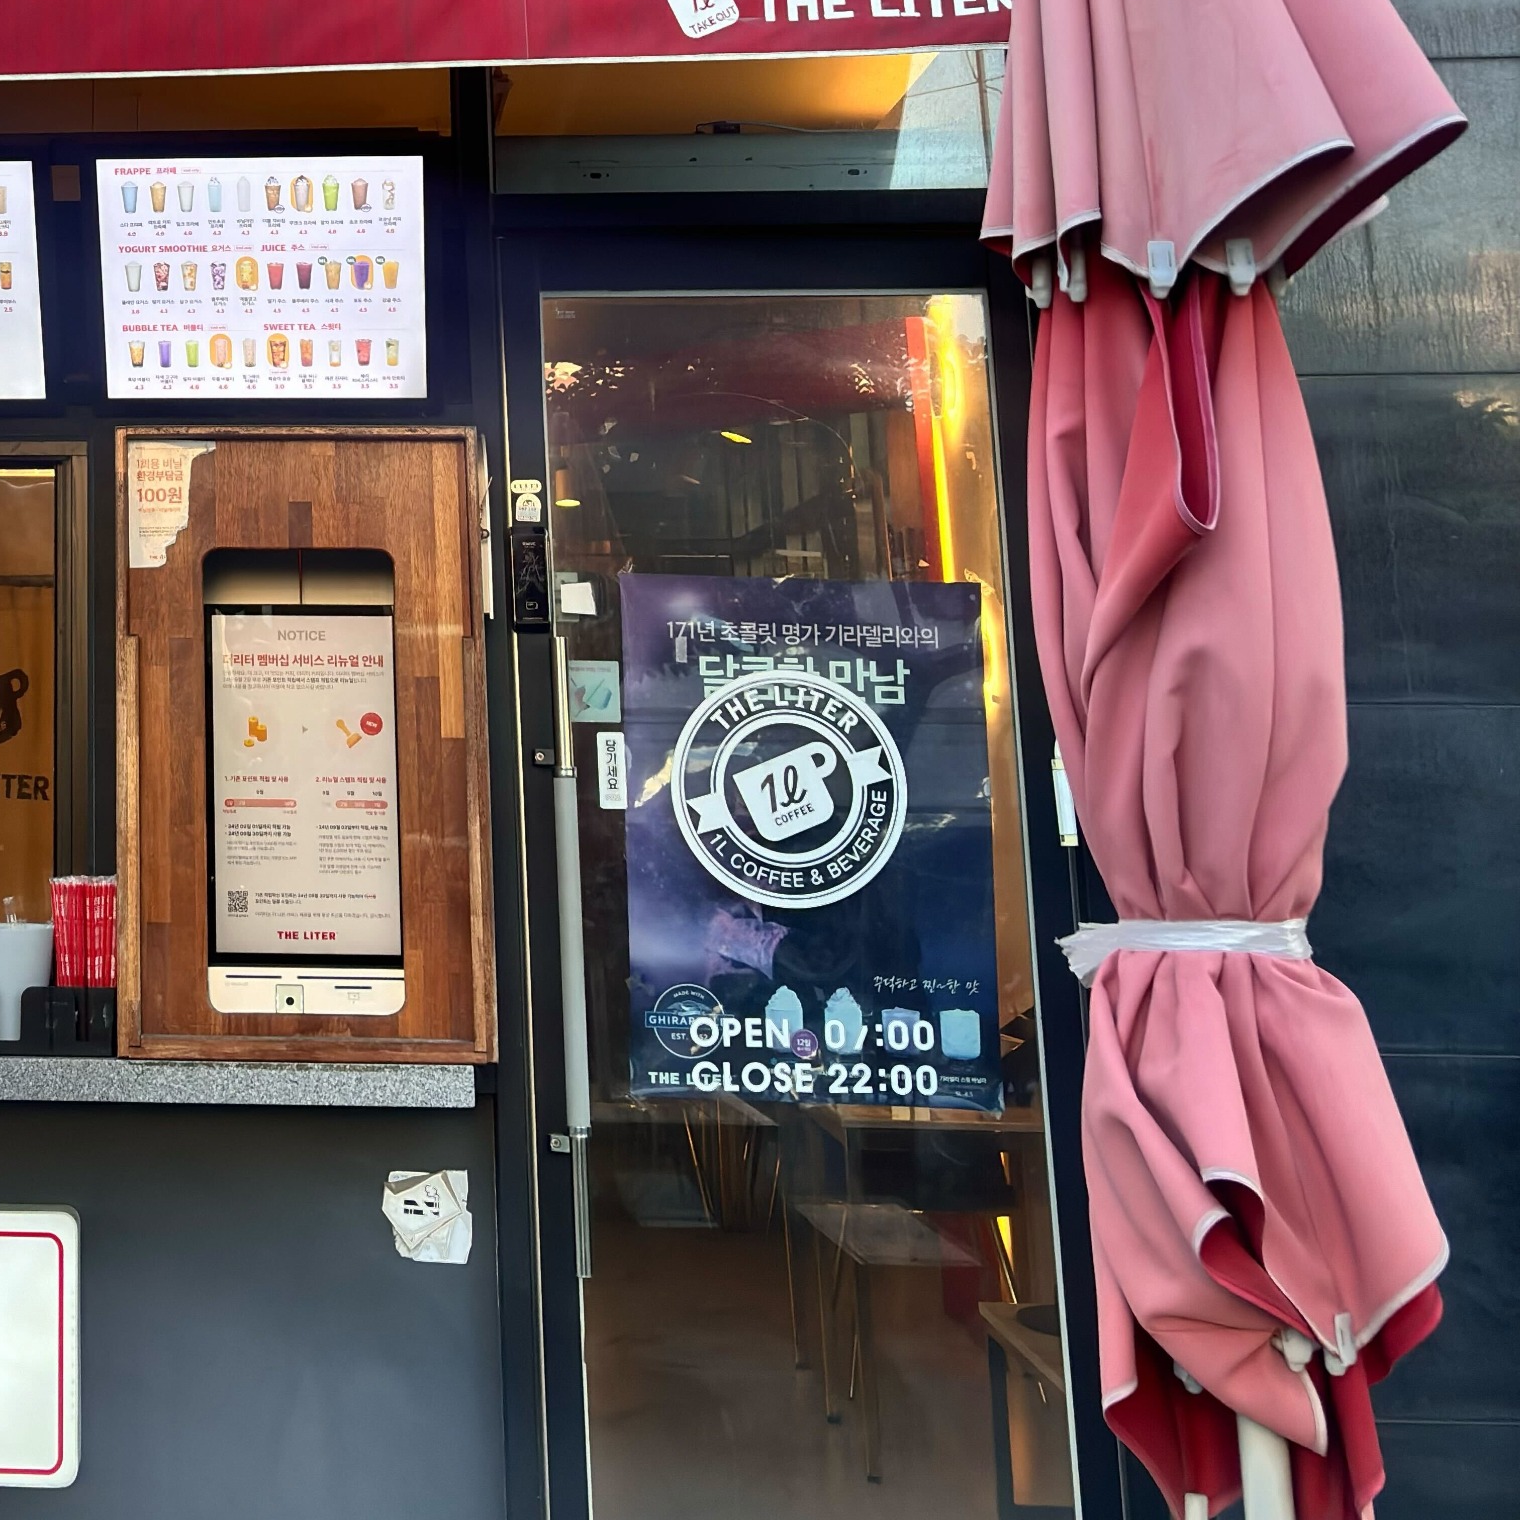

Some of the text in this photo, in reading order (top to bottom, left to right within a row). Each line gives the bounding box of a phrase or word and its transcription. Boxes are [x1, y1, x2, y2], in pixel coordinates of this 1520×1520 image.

[114, 167, 151, 175] FRAPPE
[118, 245, 157, 254] YOGURT
[158, 244, 208, 253] SMOOTHIE
[260, 244, 287, 252] JUICE
[122, 324, 159, 332] BUBBLE
[160, 324, 179, 332] TEA
[263, 323, 295, 331] SWEET
[297, 323, 316, 331] TEA
[136, 470, 184, 482] 환경부담금
[136, 486, 184, 504] 100원
[277, 630, 326, 641] NOTICE
[666, 620, 939, 649] 171년 초콜릿 명가 기라델리와의
[257, 654, 289, 668] 멤버십
[292, 654, 325, 668] 서비스
[327, 655, 360, 668] 리뉴얼
[362, 655, 384, 668] 안내
[828, 657, 911, 705] 만남
[710, 685, 859, 734] THE LITER
[606, 739, 619, 790] 당기세요
[774, 803, 816, 827] COFFEE
[729, 852, 805, 888] COFFEE
[810, 868, 825, 886] &
[826, 789, 888, 880] BEVERAGE
[277, 930, 337, 941] THE LITER
[670, 1032, 689, 1041] EST.
[689, 1017, 791, 1049] OPEN
[647, 1071, 680, 1085] THE
[691, 1061, 939, 1096] CLOSE 22:00
